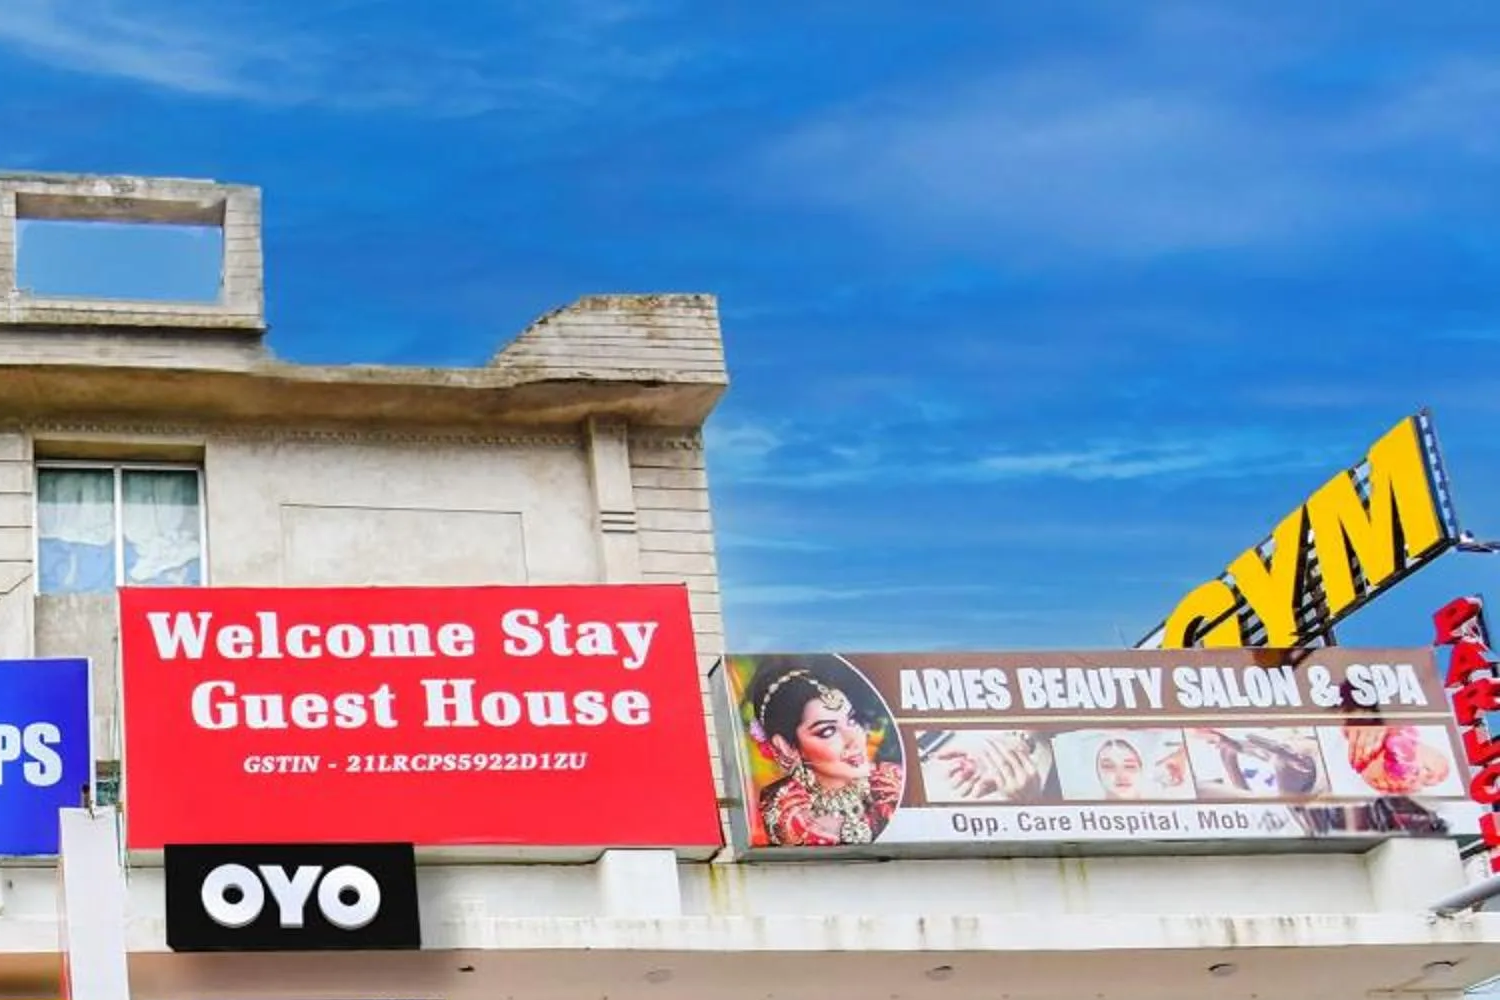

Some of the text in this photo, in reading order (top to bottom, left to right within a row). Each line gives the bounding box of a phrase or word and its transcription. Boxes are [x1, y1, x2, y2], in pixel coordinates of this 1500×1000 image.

[1160, 416, 1445, 650] GYM
[147, 609, 658, 669] Welcome Stay
[190, 678, 651, 730] Guest House
[900, 664, 1427, 711] ARIES BEAUTY SALON & SPA
[243, 754, 320, 773] GSTIN
[1017, 811, 1073, 833] Care
[1198, 808, 1250, 831] Mob
[201, 863, 381, 931] OYO
